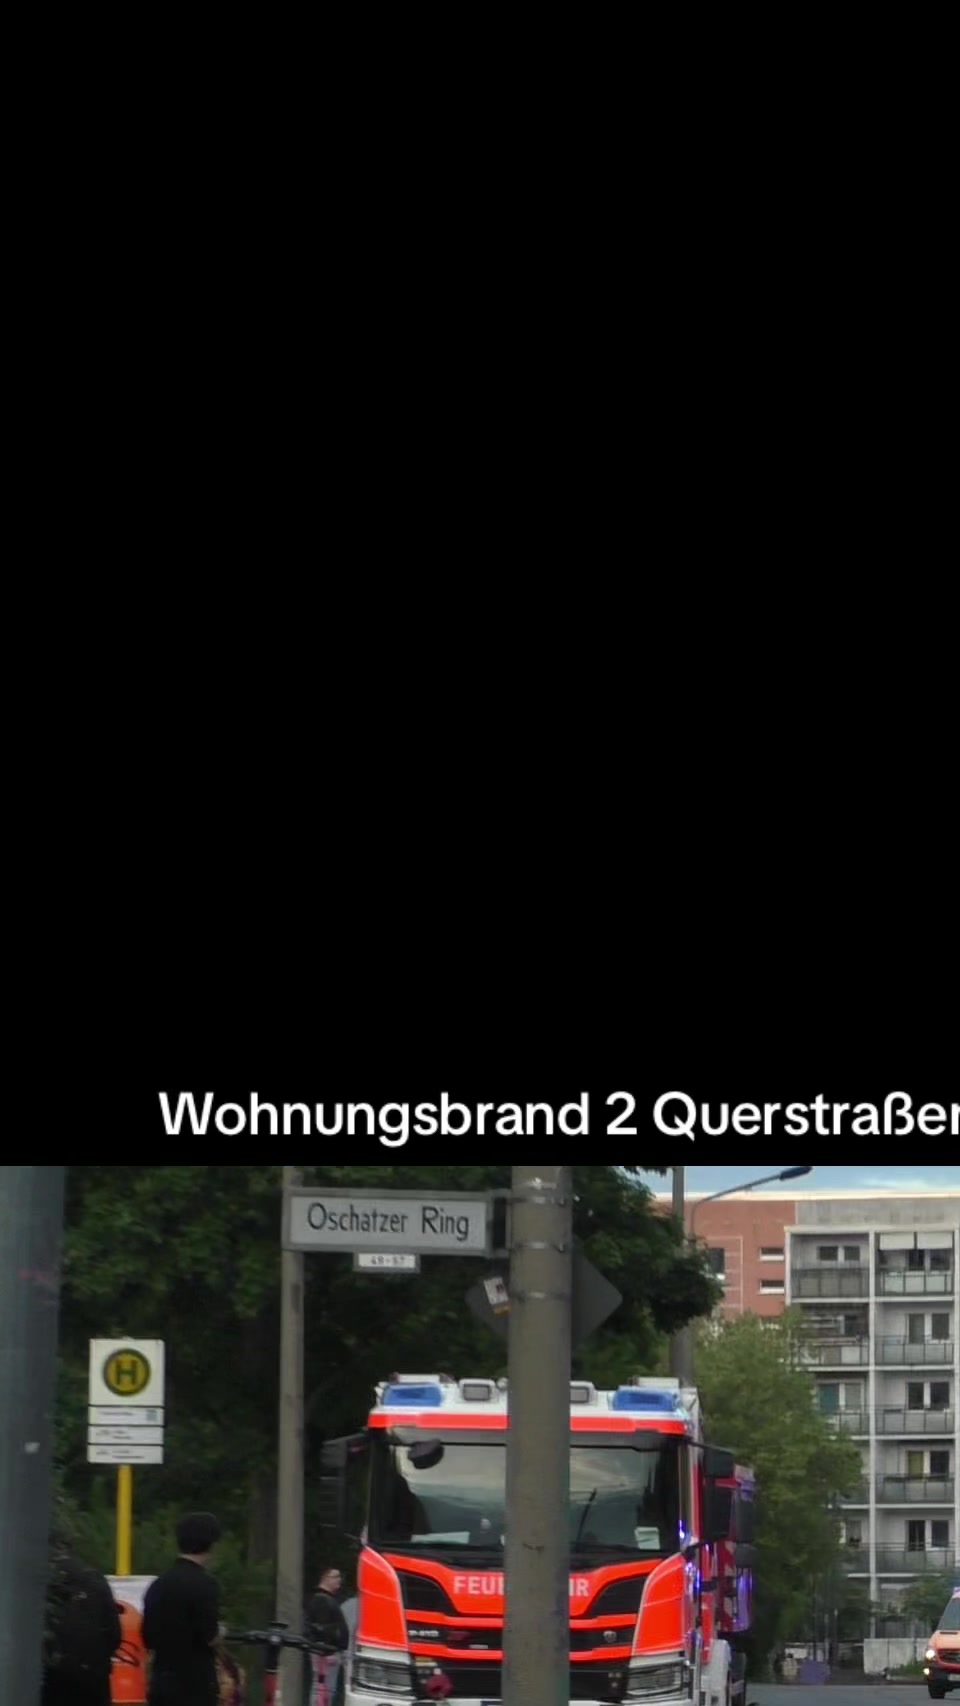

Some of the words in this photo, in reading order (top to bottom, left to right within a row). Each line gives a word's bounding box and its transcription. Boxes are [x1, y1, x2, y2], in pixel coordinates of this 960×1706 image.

[307, 1202, 408, 1233] Oschatzer
[421, 1205, 469, 1241] Ring
[116, 1360, 138, 1384] H
